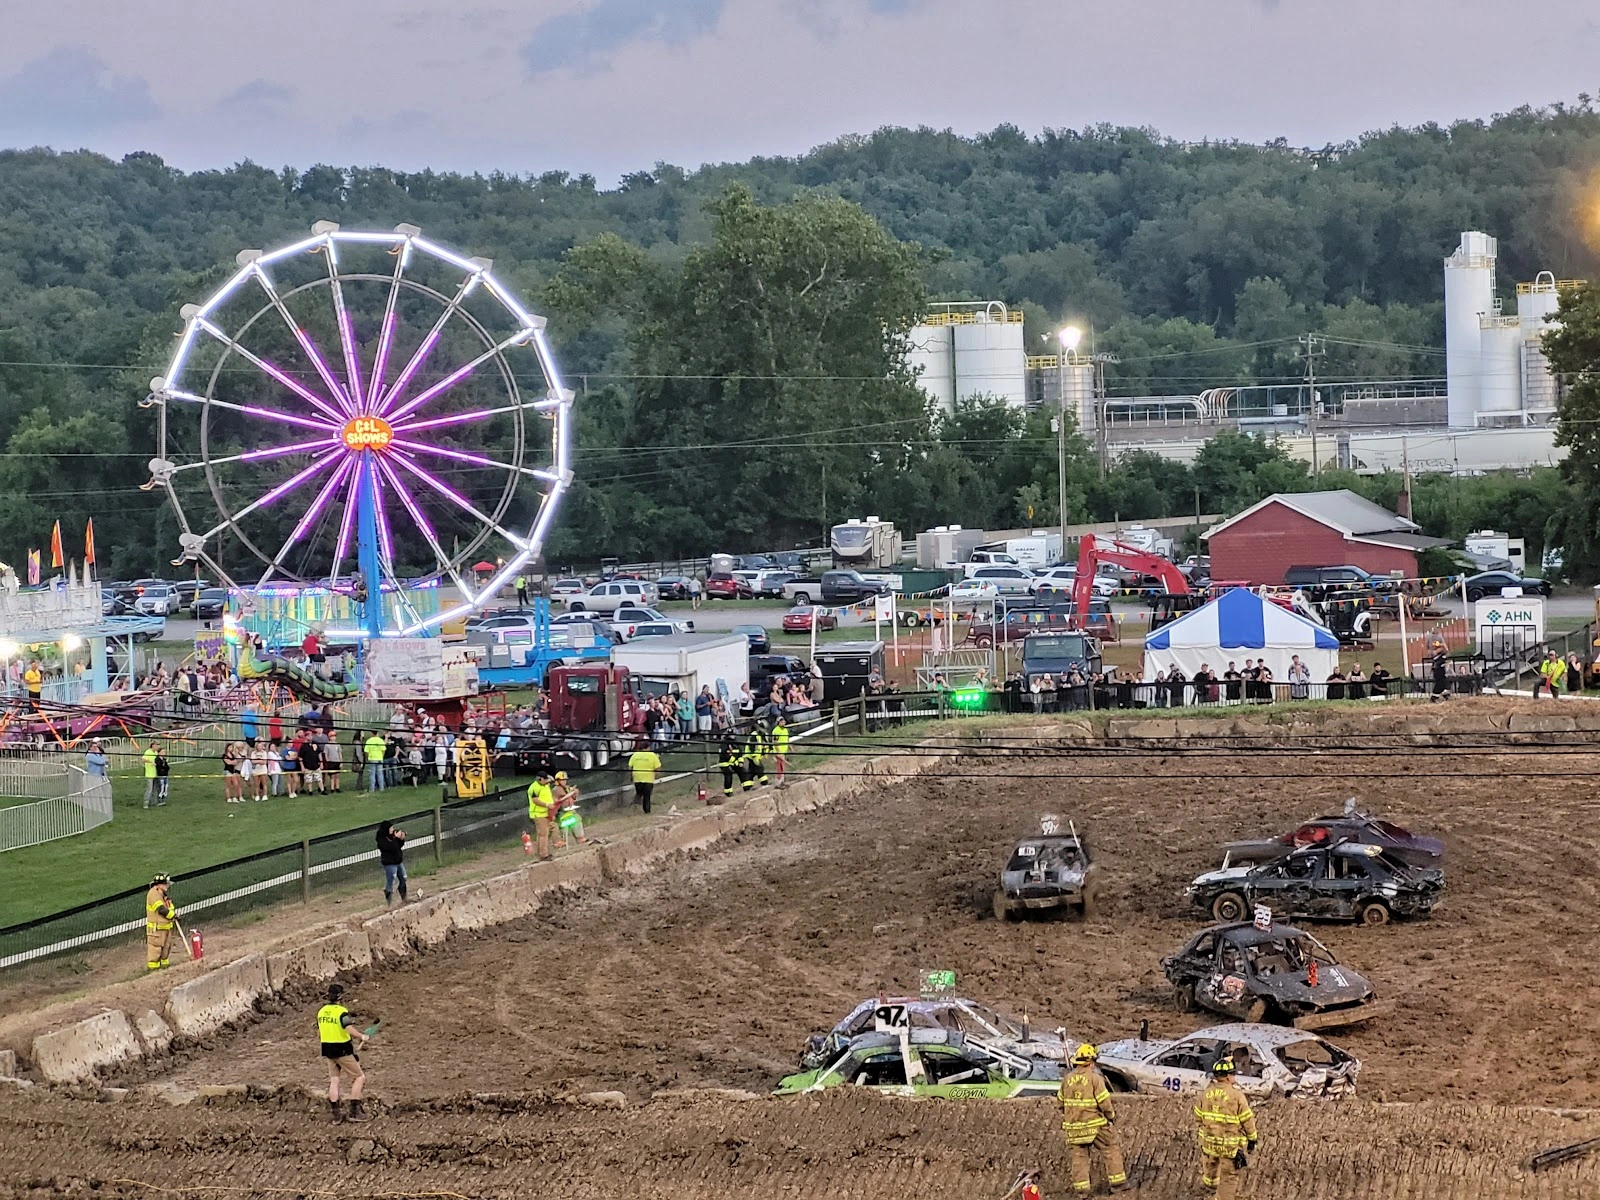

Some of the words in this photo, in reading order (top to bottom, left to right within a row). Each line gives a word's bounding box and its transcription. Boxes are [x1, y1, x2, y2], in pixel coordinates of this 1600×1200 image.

[355, 420, 380, 432] C&L
[346, 432, 389, 444] SHOWS
[1504, 610, 1533, 622] AHN
[1162, 1076, 1181, 1092] 48
